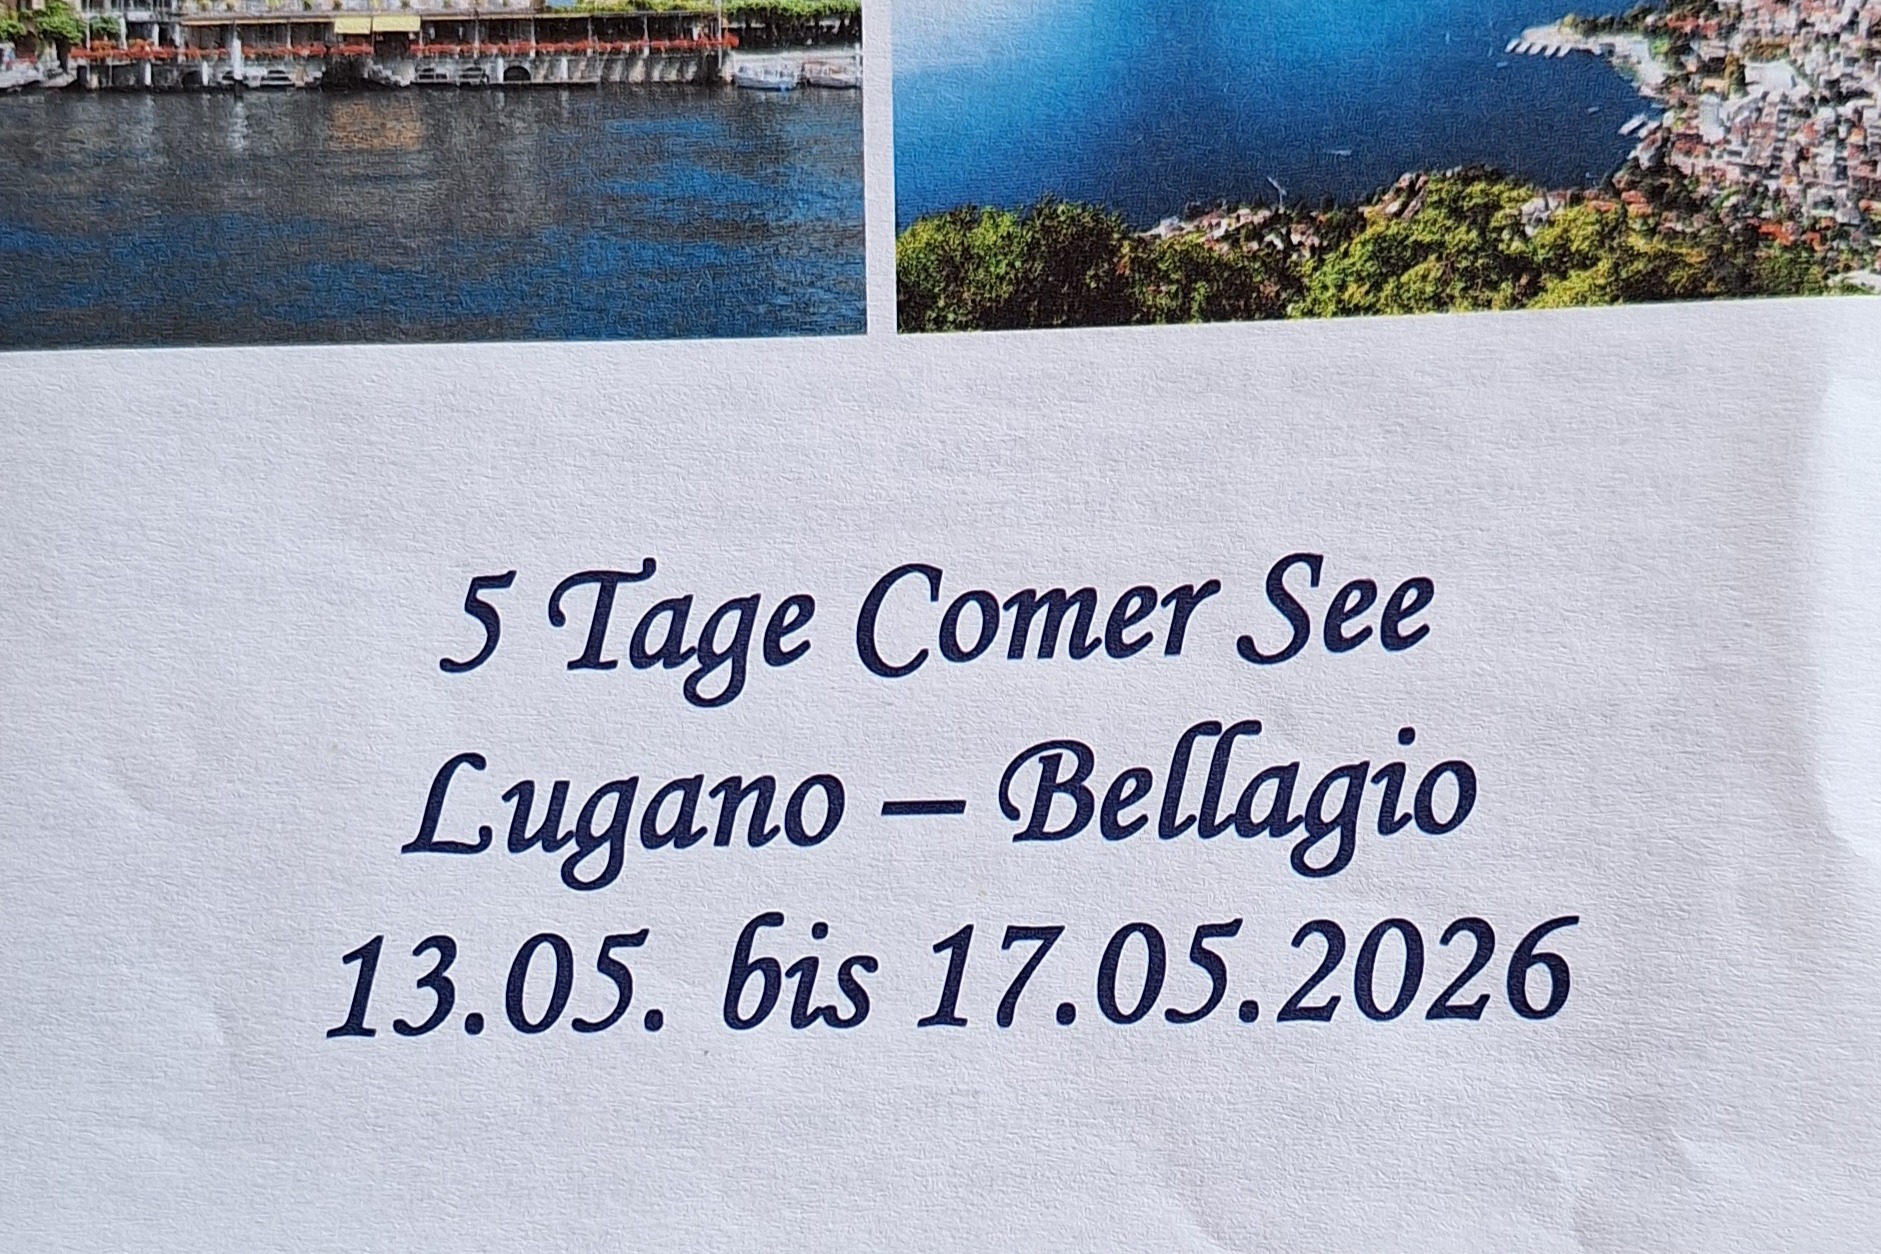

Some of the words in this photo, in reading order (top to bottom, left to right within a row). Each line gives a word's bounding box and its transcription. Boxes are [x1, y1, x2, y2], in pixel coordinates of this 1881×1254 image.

[439, 570, 517, 674] 5
[547, 557, 816, 709] Tage
[856, 563, 1222, 679] Comer
[1236, 552, 1435, 666] See
[400, 752, 846, 892] Lugano
[880, 799, 967, 816] –
[998, 719, 1477, 879] Bellagio
[326, 928, 664, 1039] 13.05.
[723, 911, 879, 1031] bis
[916, 915, 1580, 1028] 17.05.2026
